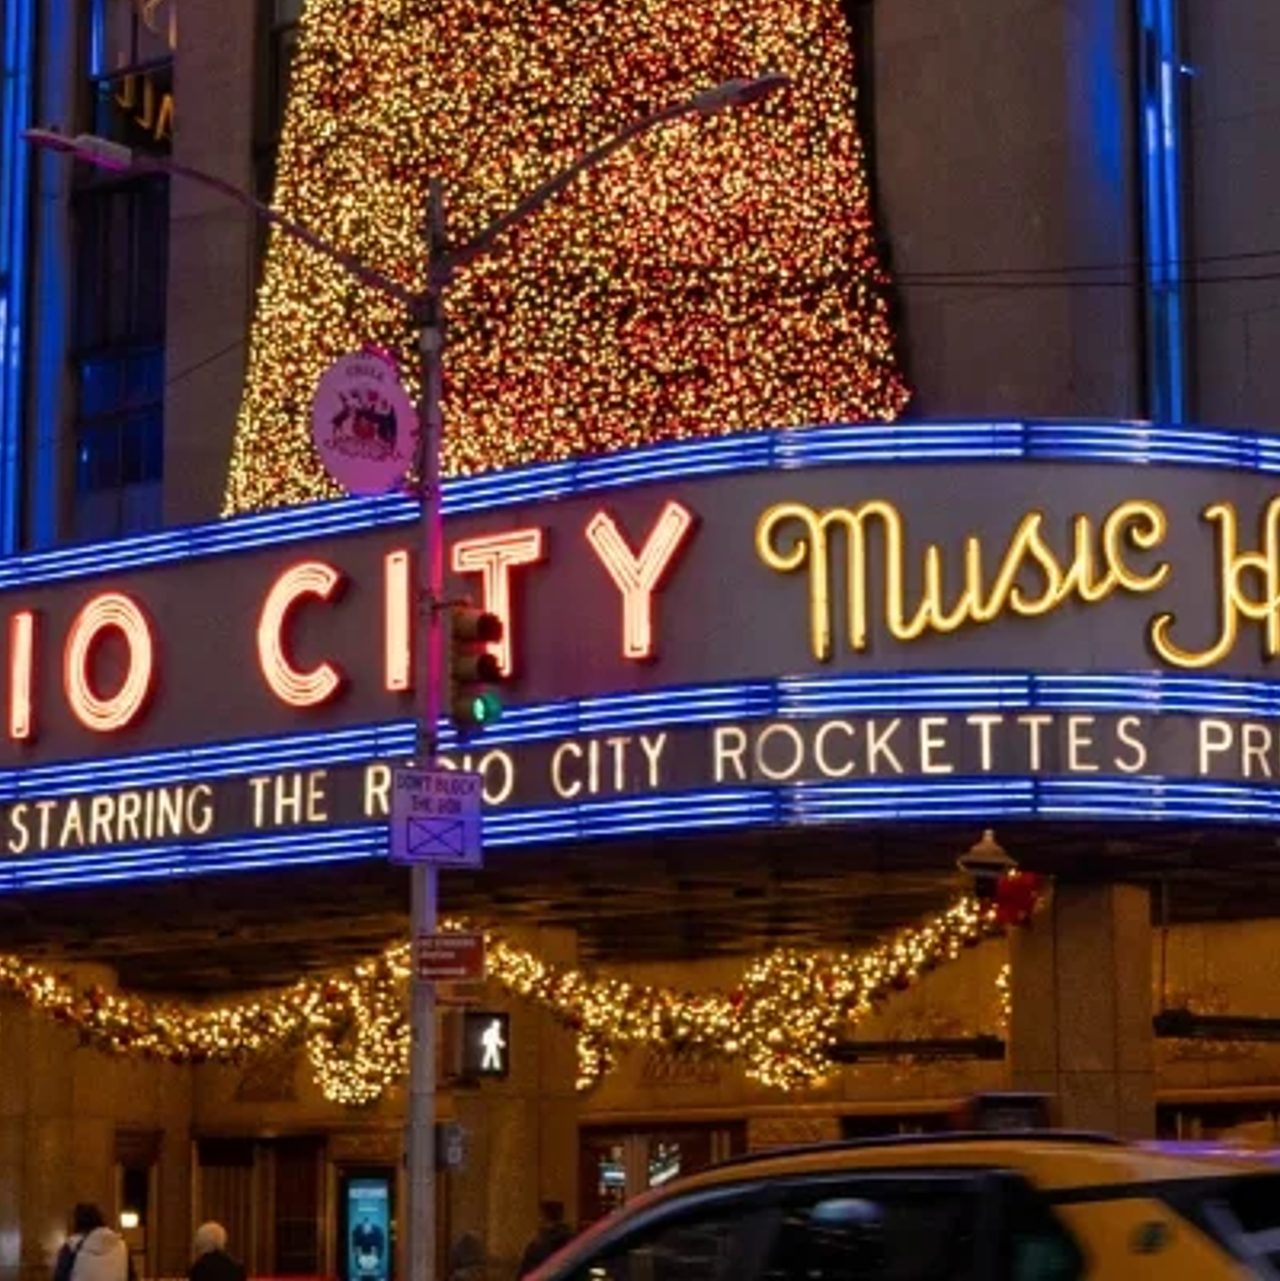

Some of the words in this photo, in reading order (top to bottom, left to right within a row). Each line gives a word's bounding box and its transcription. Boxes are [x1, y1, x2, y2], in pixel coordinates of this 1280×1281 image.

[257, 500, 692, 708] CITY
[756, 500, 1169, 660] Music
[8, 785, 213, 853] STARRING
[249, 770, 327, 823] THE
[551, 732, 666, 796] CITY
[713, 716, 1147, 780] ROCKETTES
